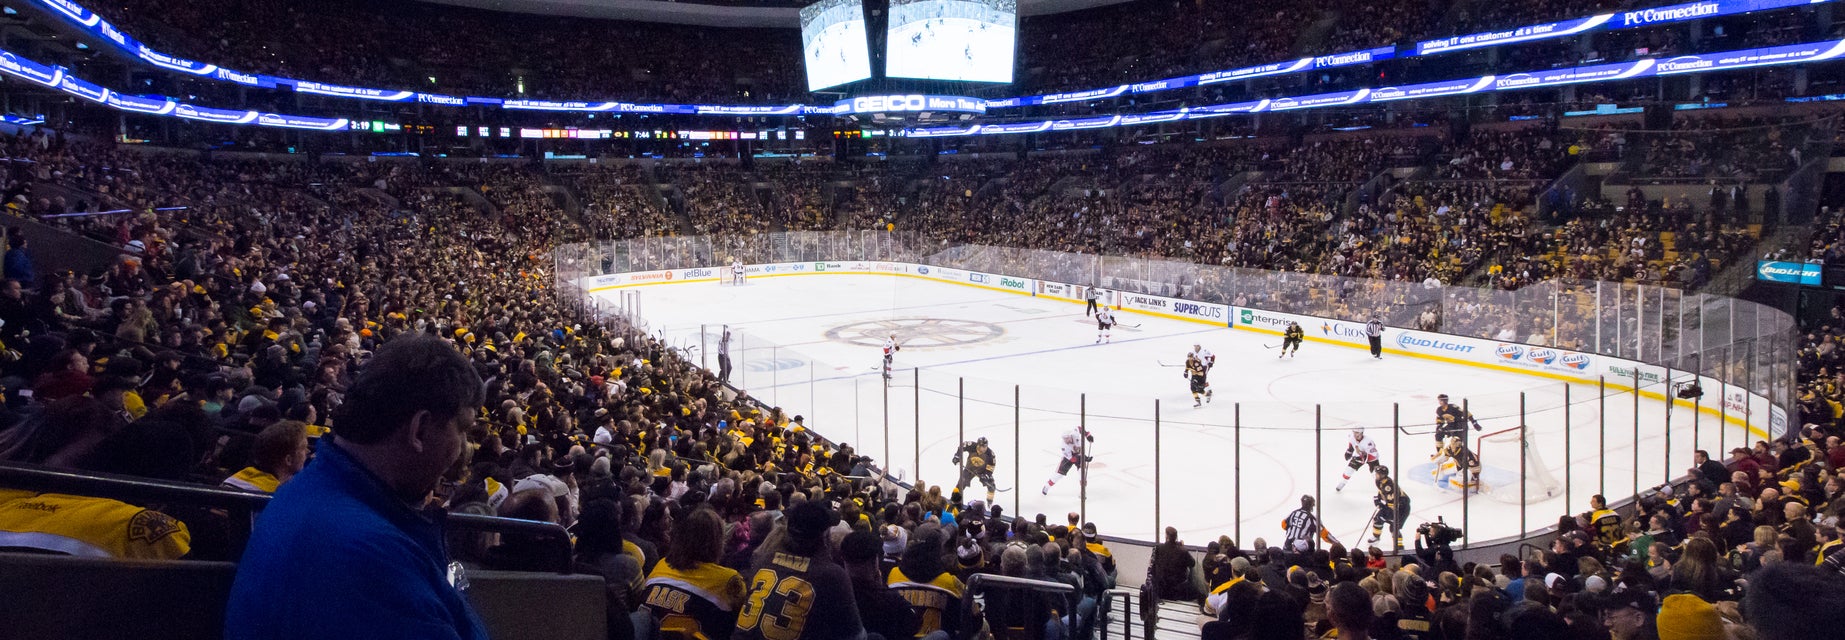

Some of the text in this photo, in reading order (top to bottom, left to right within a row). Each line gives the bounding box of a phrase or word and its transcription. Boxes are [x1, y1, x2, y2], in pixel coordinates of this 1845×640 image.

[1624, 2, 1718, 26] PC Connection
[1423, 39, 1449, 50] solving
[1451, 37, 1458, 46] IT
[1460, 36, 1475, 44] one
[1476, 31, 1513, 42] customer
[1515, 28, 1524, 37] at
[1525, 28, 1532, 36] a
[1316, 52, 1370, 67] PC Connection
[418, 94, 463, 105] PC Connection
[854, 95, 925, 113] GEICO
[929, 98, 955, 108] More
[958, 99, 975, 109] Than
[630, 104, 663, 112] Connection
[350, 121, 370, 130] 3:19
[684, 269, 712, 279] jetBlue
[1001, 278, 1025, 289] iRobot
[1135, 296, 1166, 307] JACK LINK'S
[1174, 302, 1221, 318] SUPERCUTS
[1334, 323, 1366, 338] CROS
[1432, 340, 1475, 352] LIGHT
[1498, 346, 1518, 354] Gulf
[1530, 350, 1550, 358] Gulf
[1563, 354, 1583, 362] Gulf
[1292, 517, 1304, 529] 32
[645, 585, 690, 614] RASK
[736, 568, 816, 640] 33
